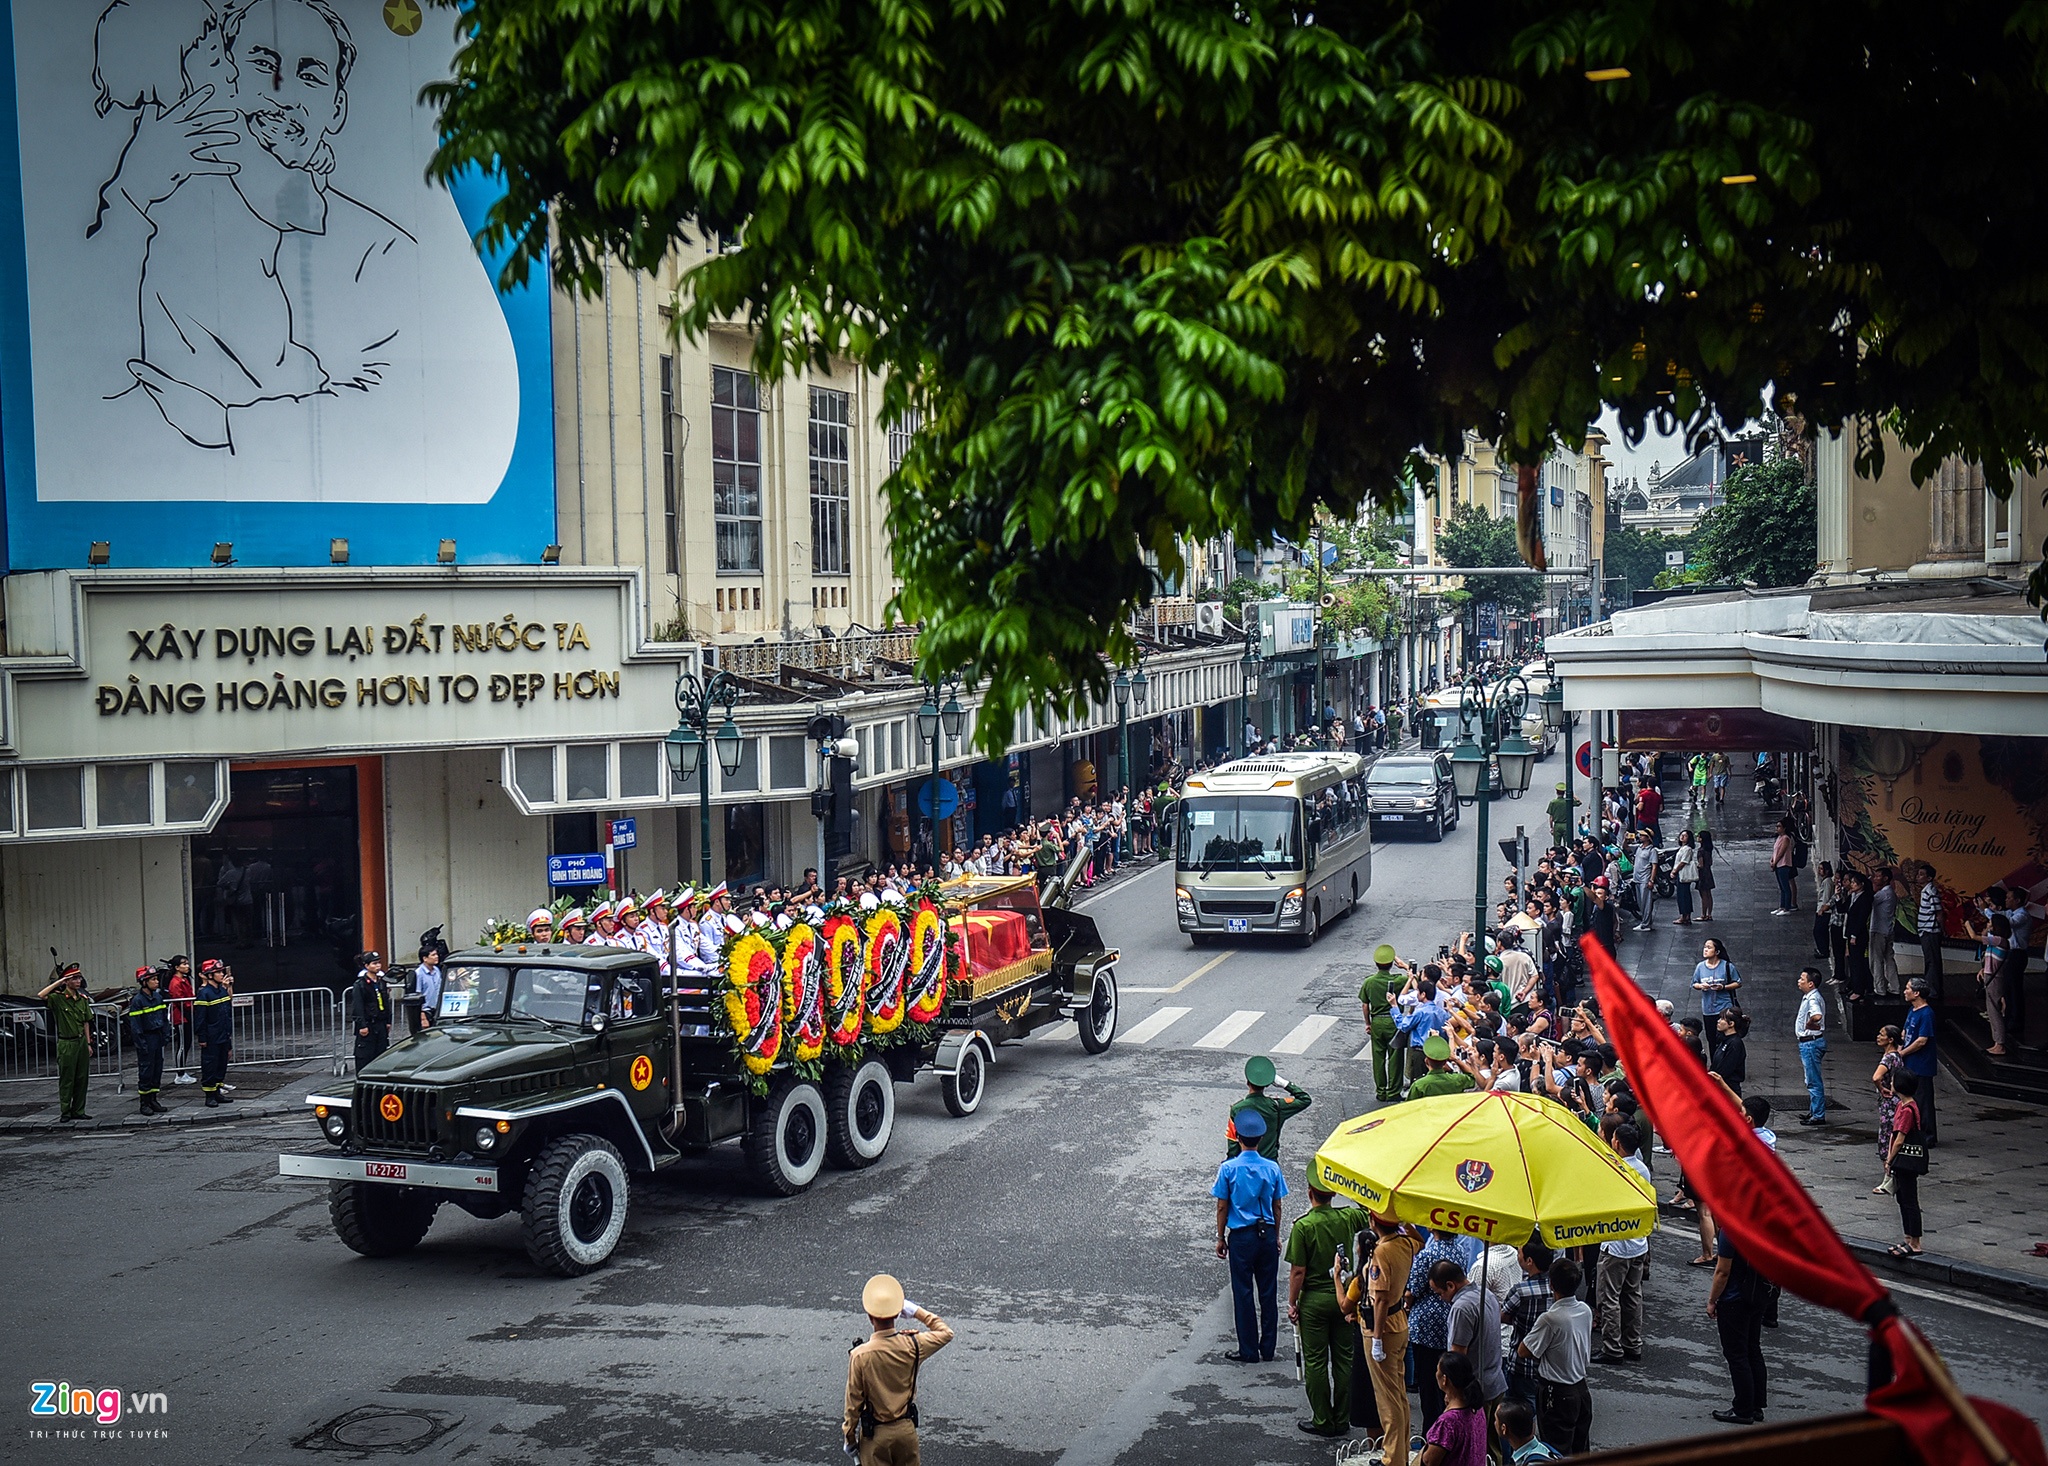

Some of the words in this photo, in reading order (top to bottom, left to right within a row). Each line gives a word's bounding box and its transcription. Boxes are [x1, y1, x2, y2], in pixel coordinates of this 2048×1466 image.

[128, 622, 206, 661] XÂY
[215, 624, 316, 665] DỰNG
[325, 625, 374, 661] LẠI
[382, 613, 445, 654] ĐẤT
[452, 613, 548, 651] NƯỚC
[553, 622, 591, 651] TA
[95, 673, 206, 716] ĐÀNG
[215, 670, 347, 711] HOÀNG
[356, 674, 431, 706] HƠN
[438, 673, 480, 704] TO
[488, 672, 546, 709] ĐẸP
[553, 668, 621, 700] HƠN
[1897, 795, 1941, 825] Quà
[1943, 808, 1986, 839] tăng
[1927, 825, 1979, 854] Mùa
[1980, 836, 2006, 857] thu
[568, 858, 586, 868] PHỐ
[449, 1001, 461, 1012] 12
[1323, 1165, 1381, 1203] Eurowindow
[1429, 1207, 1498, 1237] CSGT
[1554, 1217, 1641, 1241] Eurowindow
